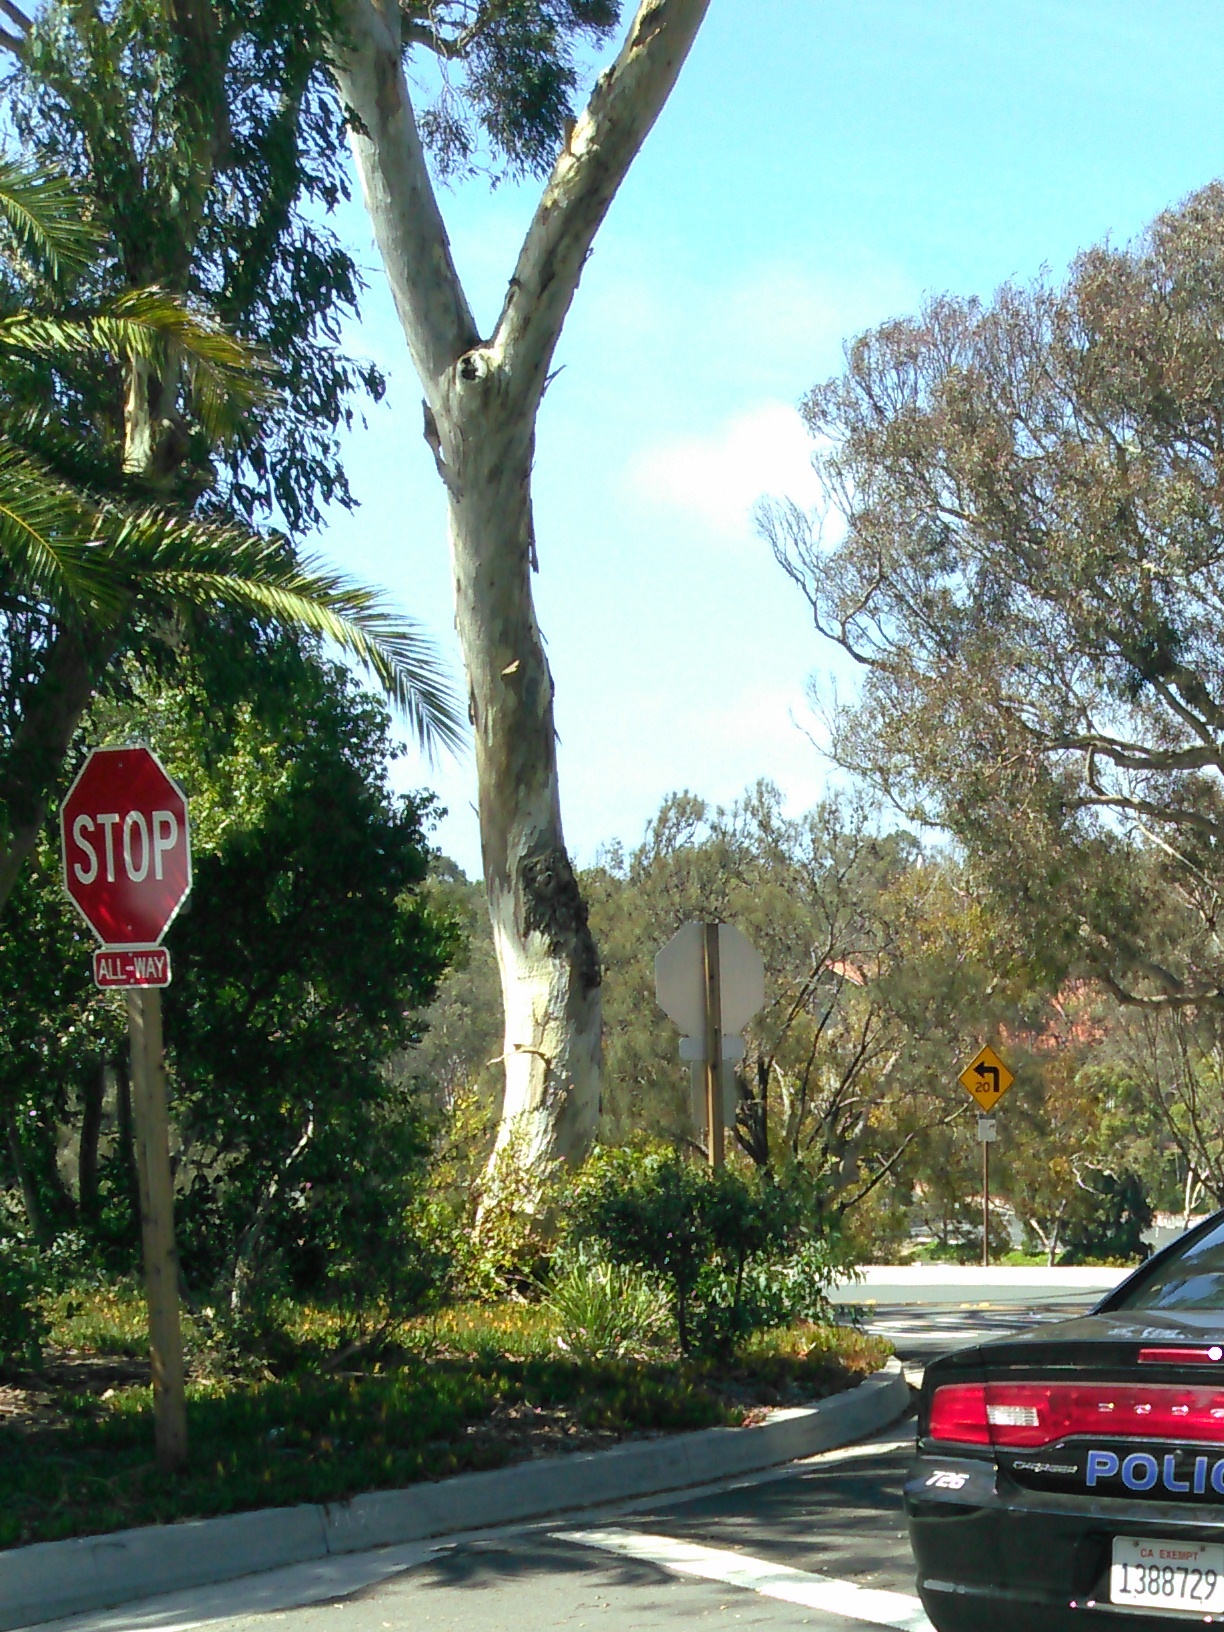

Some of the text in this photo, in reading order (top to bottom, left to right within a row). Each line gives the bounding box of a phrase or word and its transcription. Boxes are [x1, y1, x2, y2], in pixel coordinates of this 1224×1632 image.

[73, 809, 179, 885] STOP
[98, 958, 164, 980] ALL-WAY
[975, 1082, 990, 1092] 20
[925, 1460, 971, 1490] 726
[1140, 1548, 1199, 1561] CA EXEMPT
[1119, 1562, 1218, 1601] 1388729
